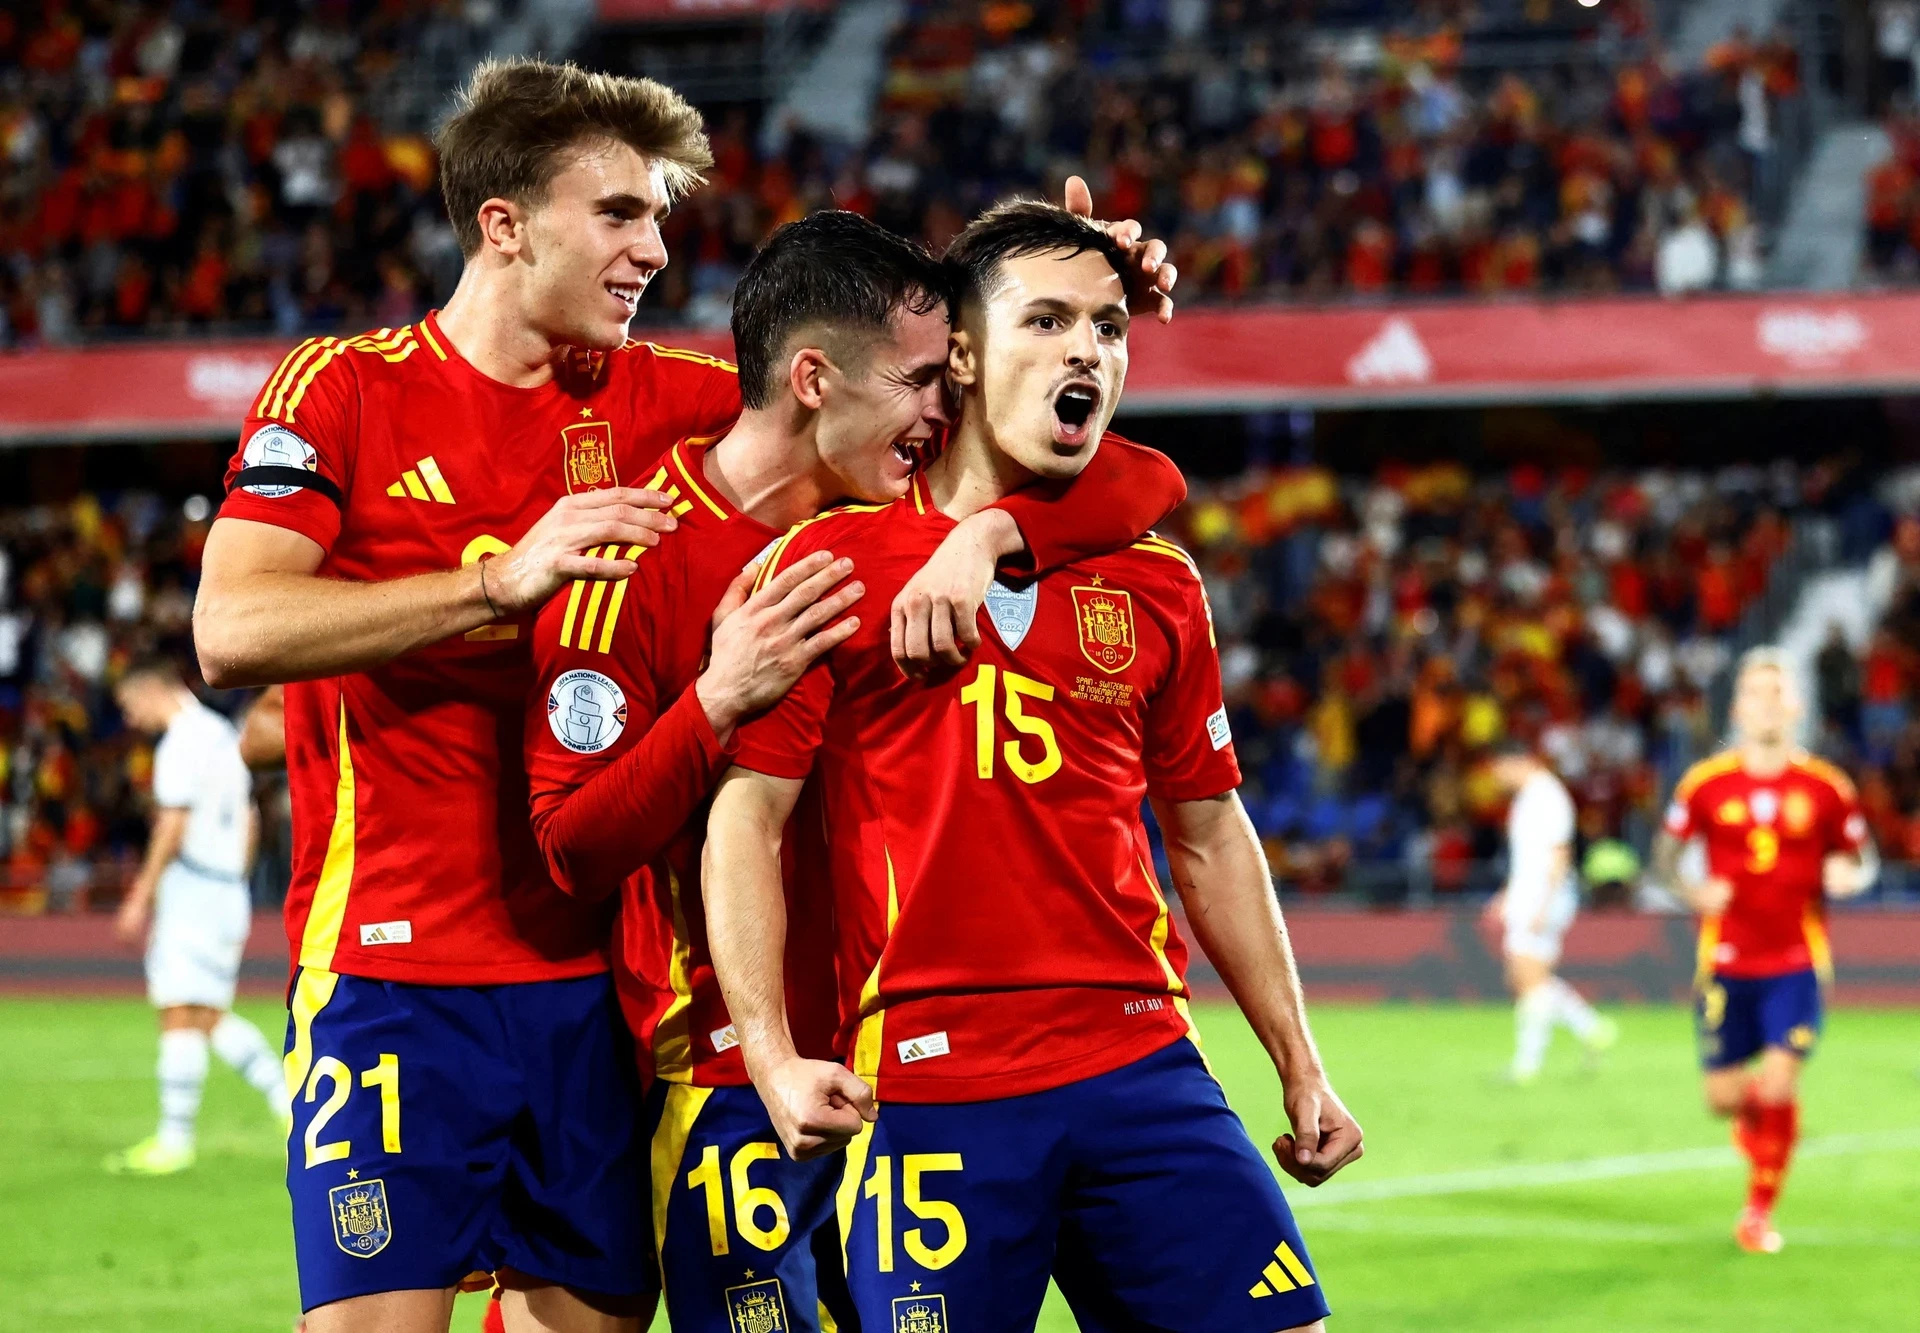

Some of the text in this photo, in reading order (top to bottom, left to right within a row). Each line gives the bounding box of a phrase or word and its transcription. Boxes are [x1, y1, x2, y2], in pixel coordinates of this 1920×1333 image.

[986, 591, 1032, 600] CHAMPIONS
[1000, 623, 1023, 631] 2024
[557, 672, 620, 696] UEFA NATIONS LEAGUE
[1075, 676, 1094, 686] SPAIN
[1099, 680, 1134, 693] SWITZERLAND
[1078, 684, 1086, 692] 18
[1086, 685, 1117, 697] NOVEMBER
[1070, 690, 1088, 700] SANTA
[1089, 694, 1105, 703] CRUZ
[1105, 697, 1113, 705] DE
[961, 664, 1062, 784] 15
[563, 737, 603, 752] WINNER 2023
[304, 1053, 402, 1170] 21
[687, 1141, 791, 1256] 16
[864, 1152, 967, 1272] 15
